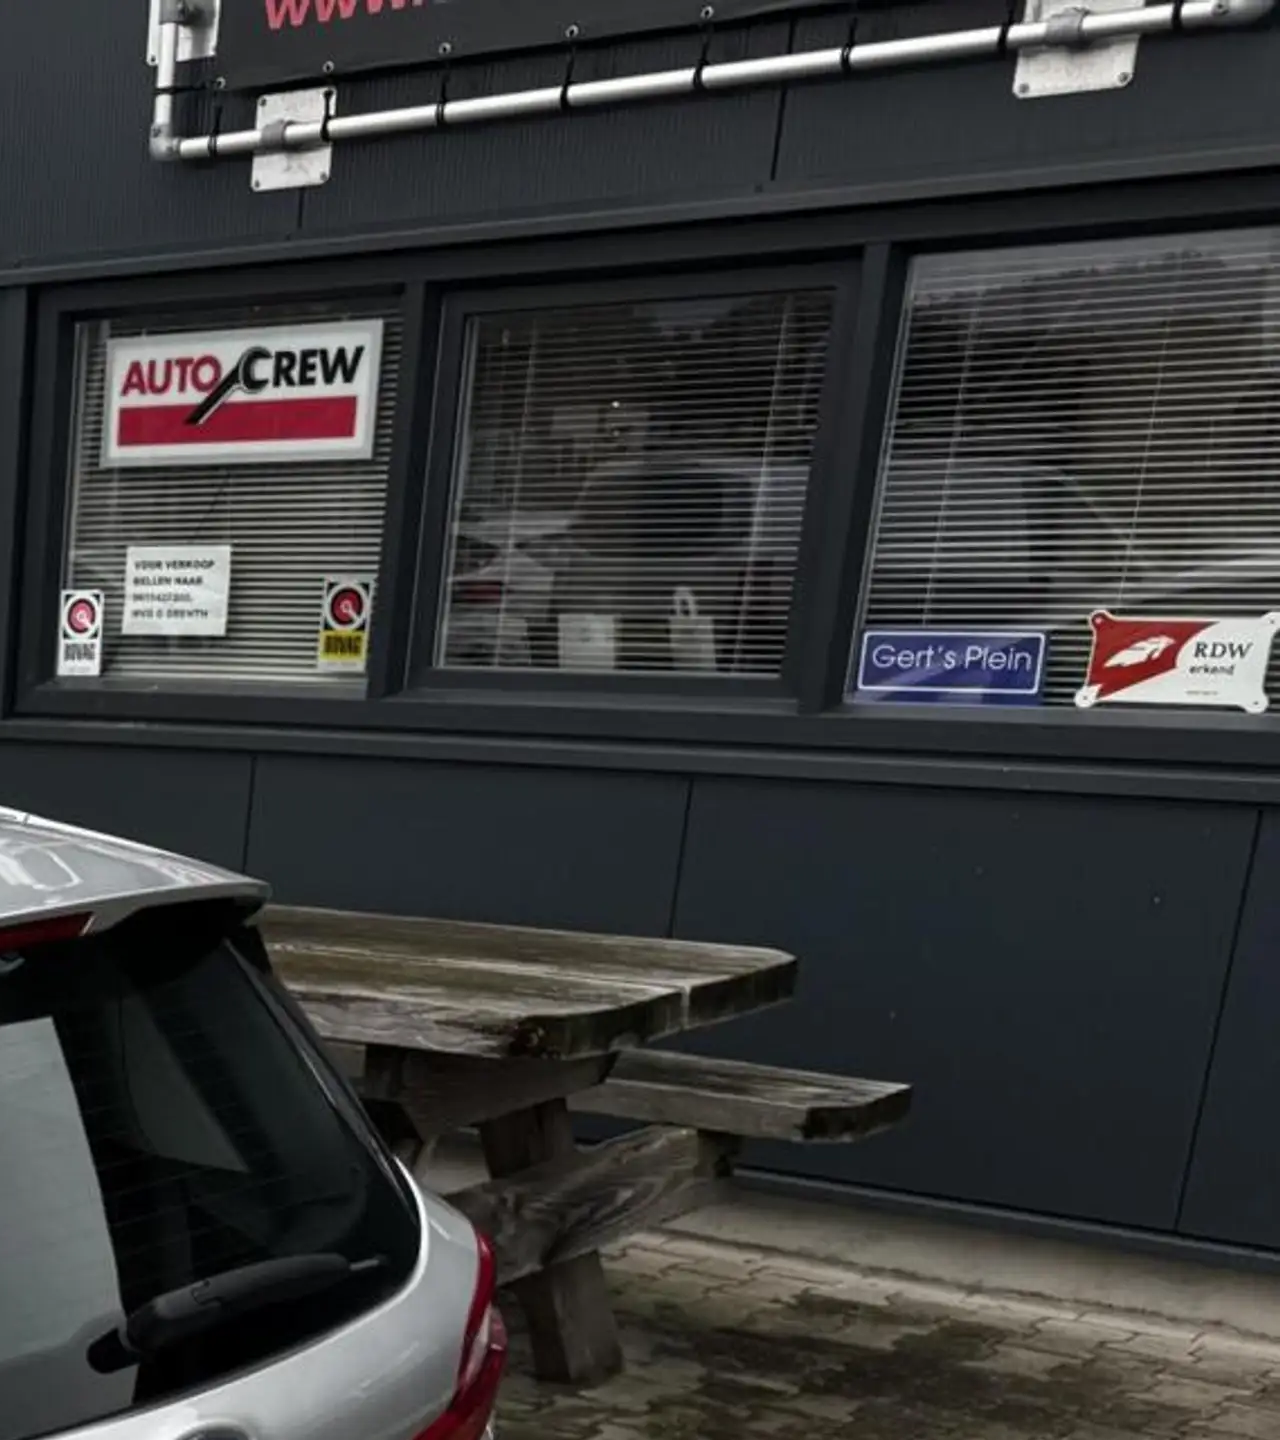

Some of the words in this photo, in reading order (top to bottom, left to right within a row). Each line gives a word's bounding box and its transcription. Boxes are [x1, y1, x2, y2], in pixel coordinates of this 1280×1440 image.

[121, 355, 222, 397] AUTO
[241, 346, 365, 393] CREW
[872, 645, 957, 669] Gert's
[964, 645, 1033, 671] Plein
[1193, 641, 1253, 660] RDW
